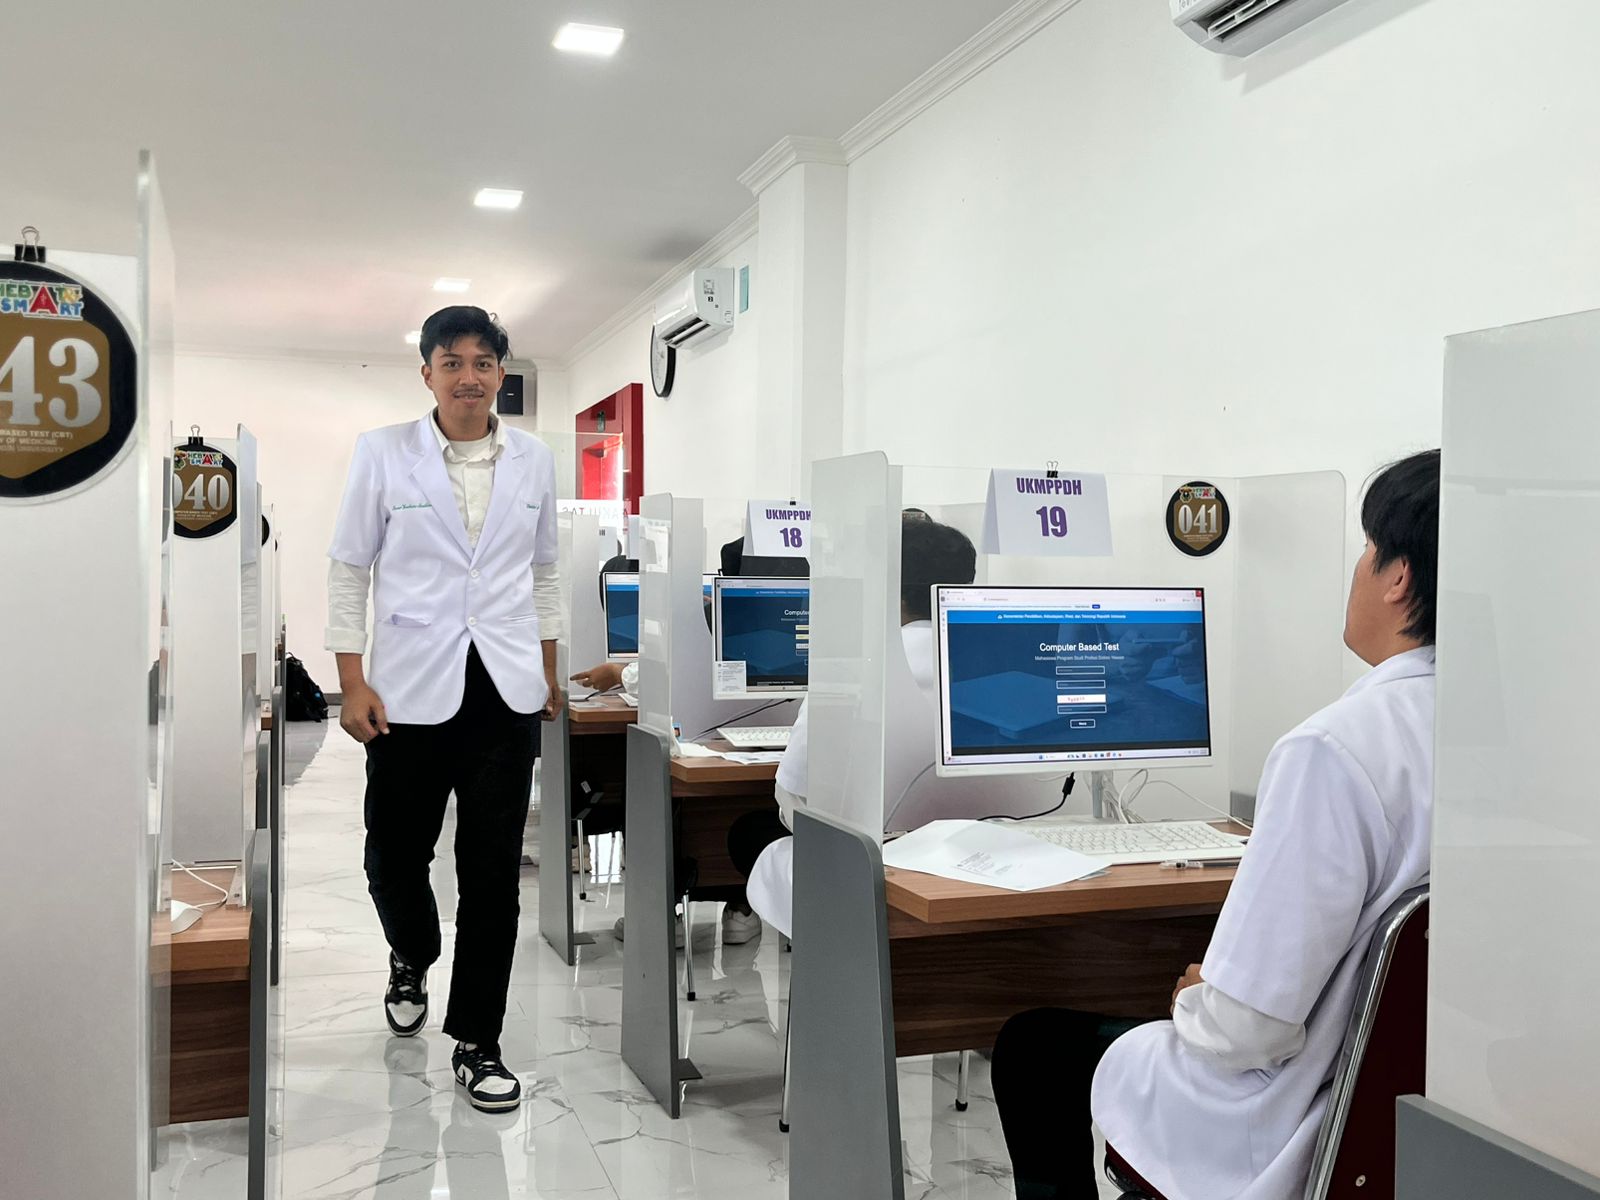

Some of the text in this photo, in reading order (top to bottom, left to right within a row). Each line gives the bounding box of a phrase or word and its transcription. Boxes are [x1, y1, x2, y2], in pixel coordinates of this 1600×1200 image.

[1, 299, 83, 316] SMART
[1016, 477, 1082, 496] UKMPPDH
[766, 508, 811, 521] UKMPPDH
[1036, 506, 1068, 538] 19
[1178, 504, 1218, 534] 041
[779, 527, 803, 548] 18
[1039, 642, 1120, 653] Computer Based Test
